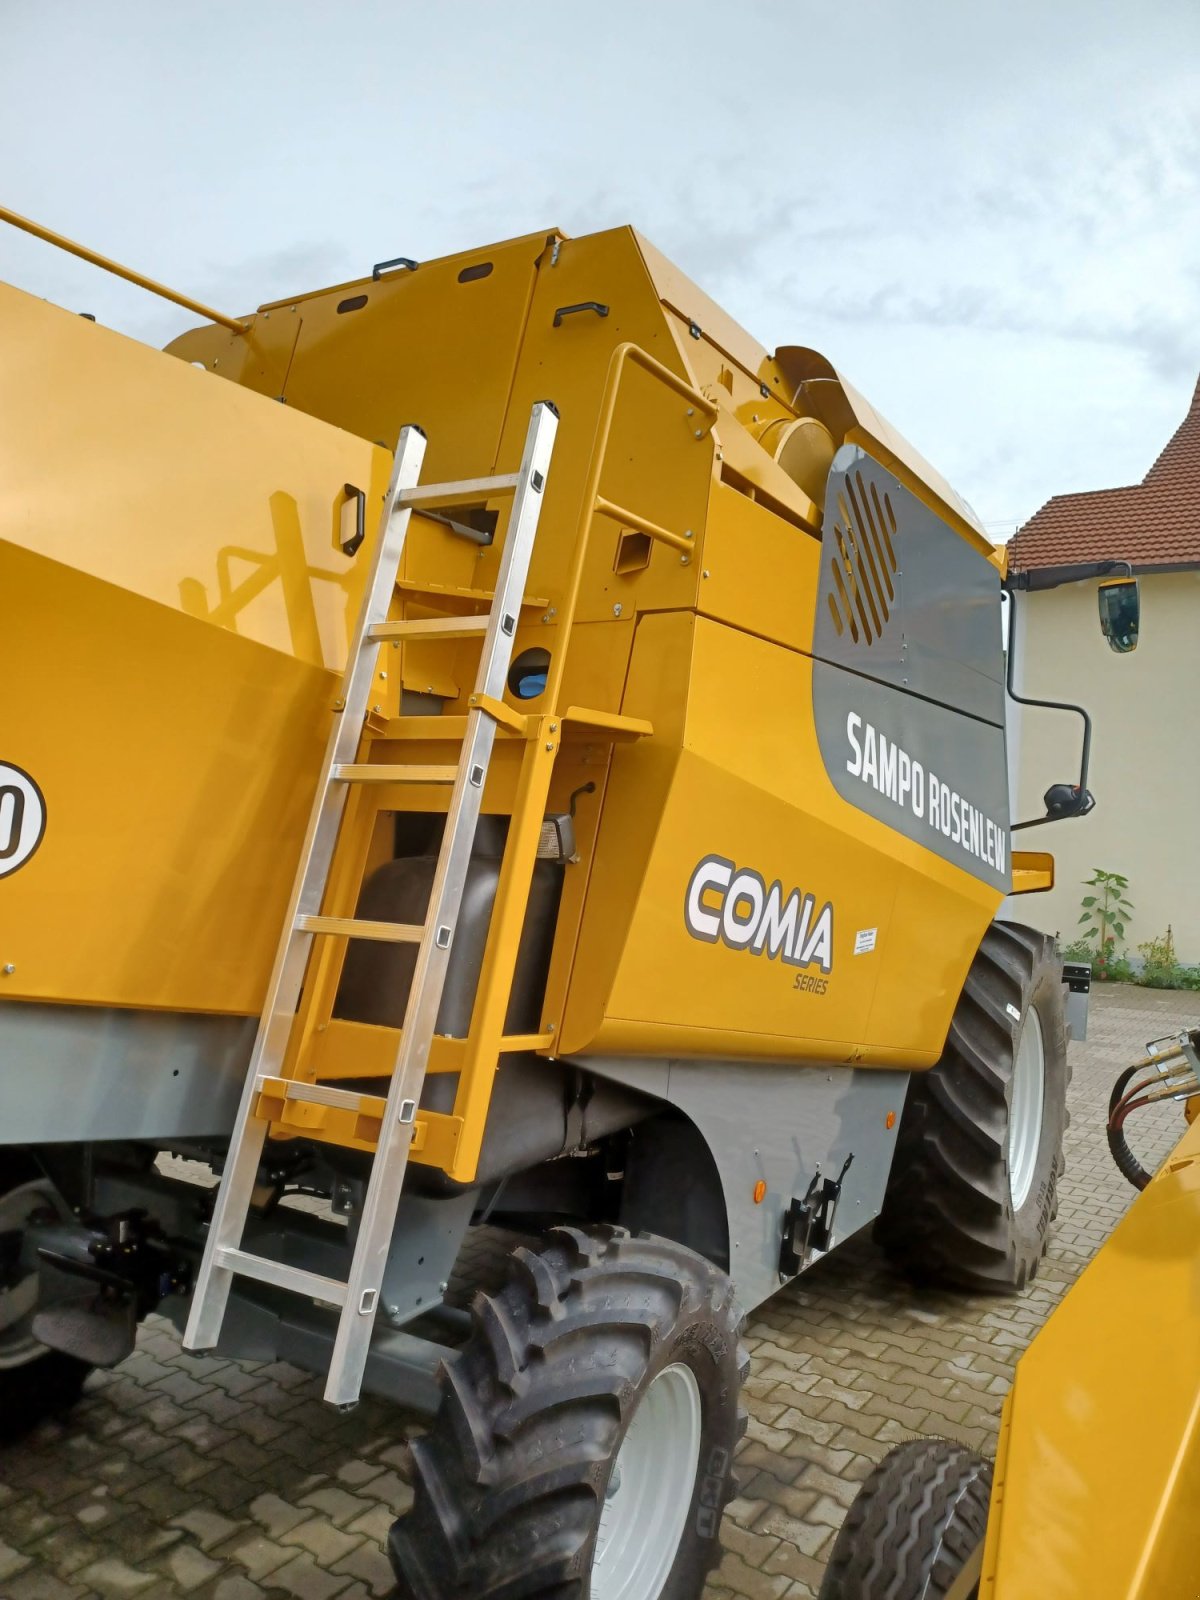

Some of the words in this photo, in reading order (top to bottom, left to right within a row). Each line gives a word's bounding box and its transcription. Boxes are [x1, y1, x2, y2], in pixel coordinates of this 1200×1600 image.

[846, 711, 924, 818] SAMPO
[929, 772, 1006, 875] ROSENLEW
[685, 854, 833, 974] COMIA
[792, 973, 829, 995] SERIES
[696, 1447, 728, 1539] BKT
